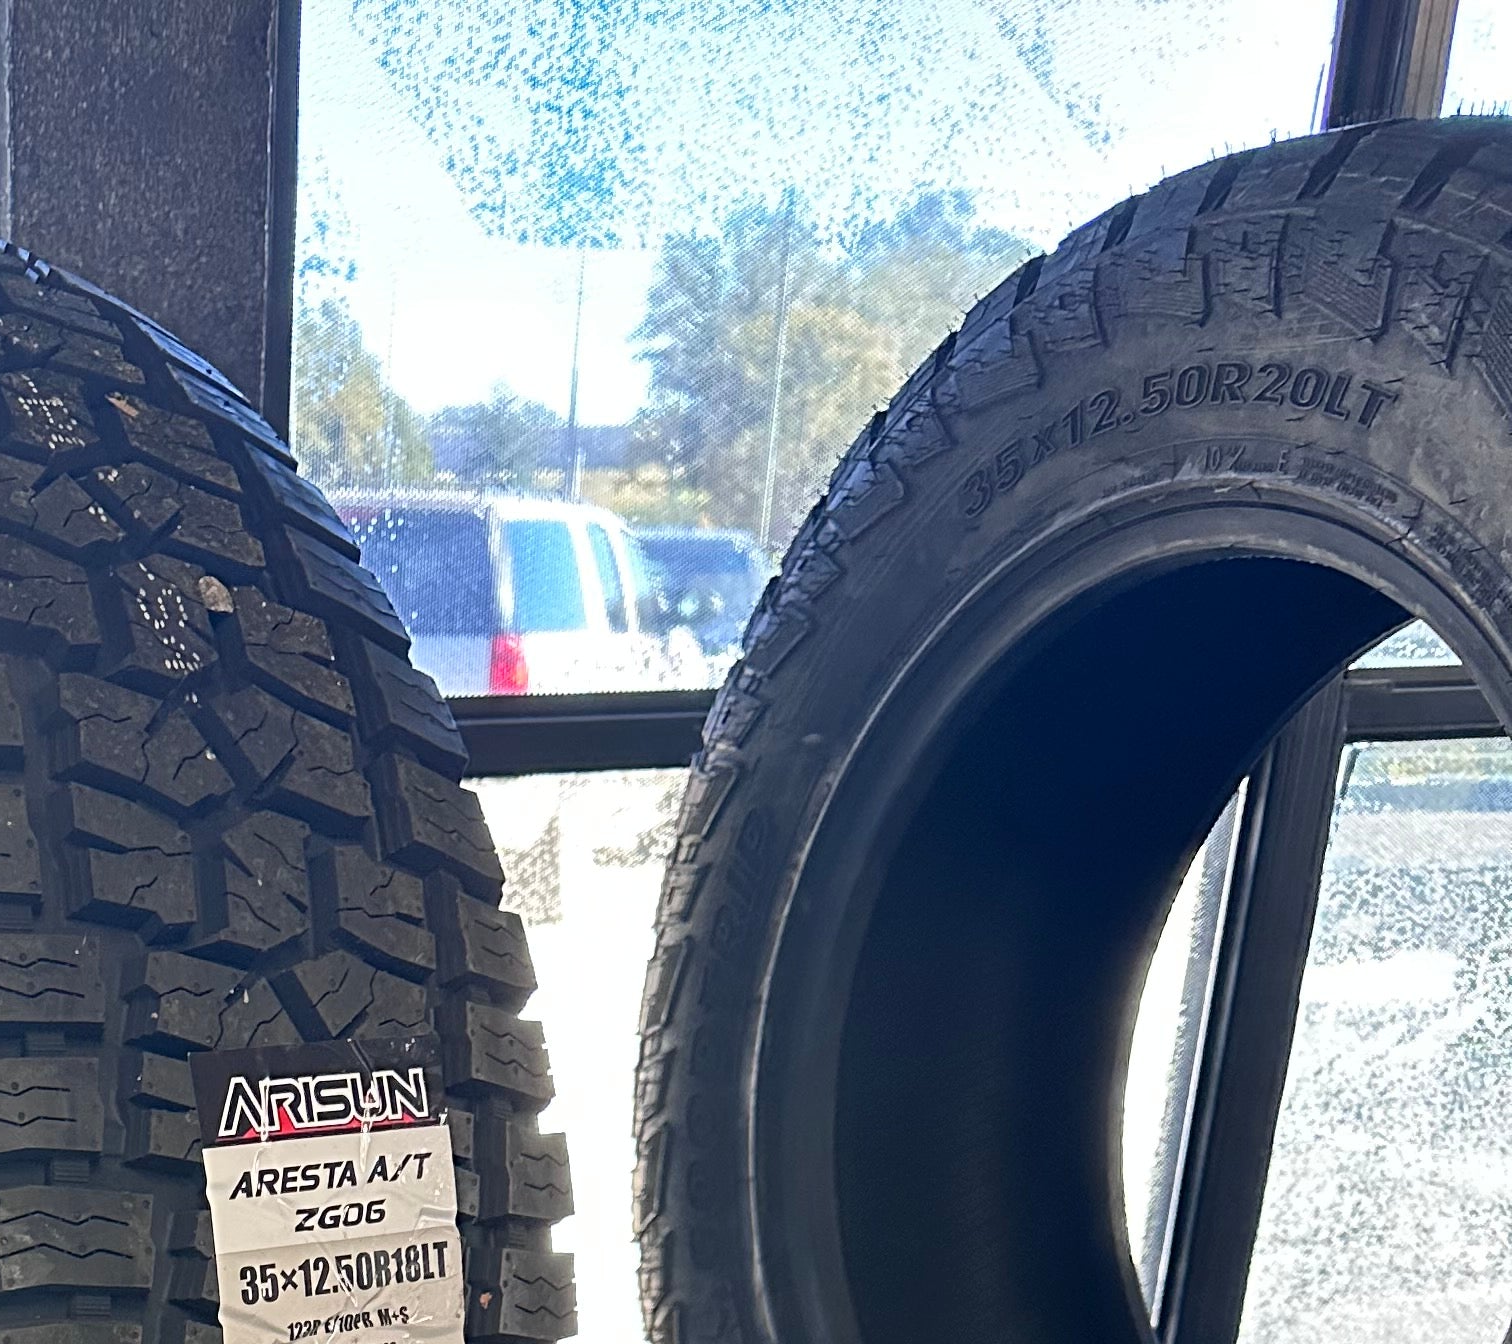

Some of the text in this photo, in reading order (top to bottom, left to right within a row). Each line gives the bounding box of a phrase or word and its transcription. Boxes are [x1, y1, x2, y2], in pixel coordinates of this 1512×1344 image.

[958, 363, 1402, 520] 35x12.50R20LT
[218, 1067, 431, 1138] ARISUN
[228, 1152, 432, 1200] ARESTA A/T
[294, 1199, 386, 1232] ZG06
[377, 1306, 409, 1327] M+S
